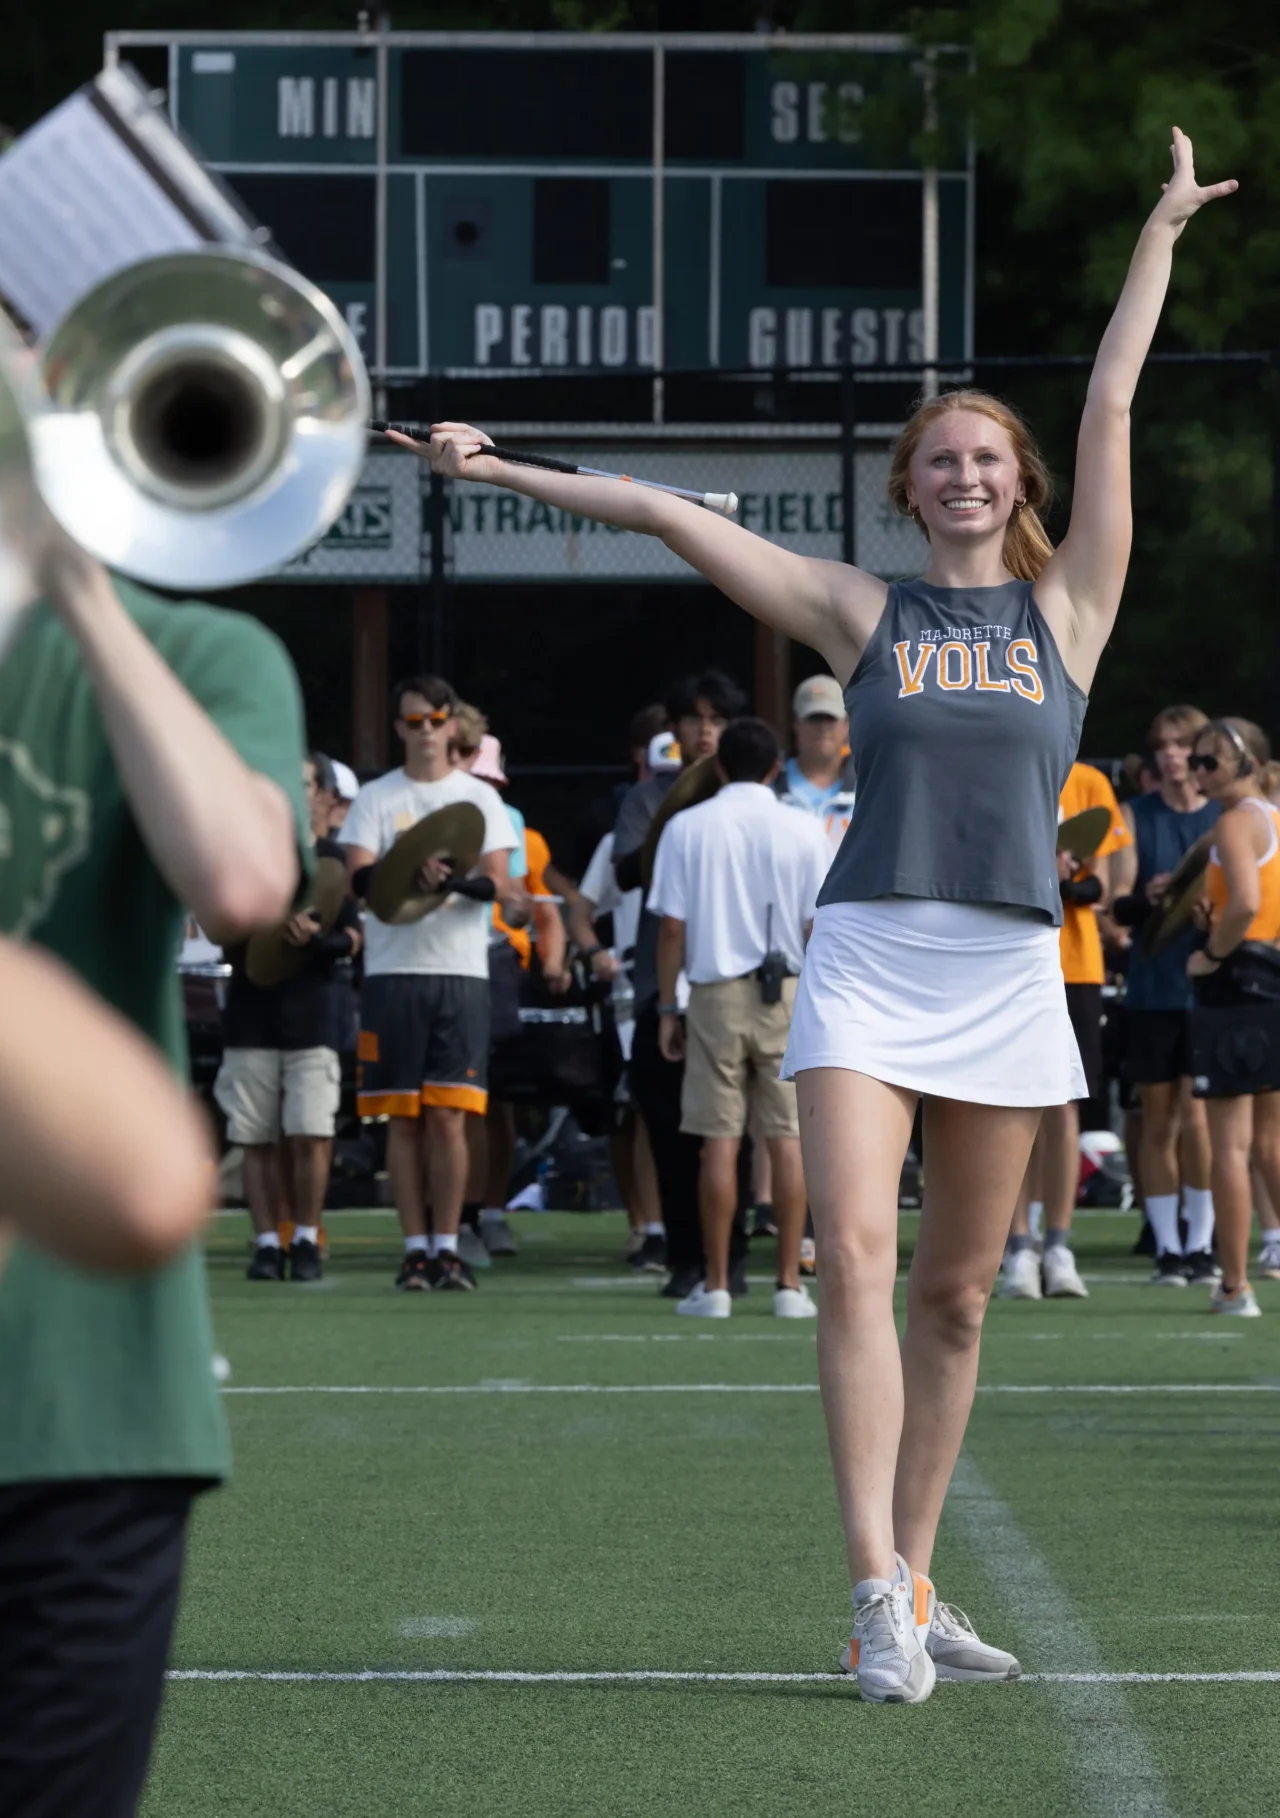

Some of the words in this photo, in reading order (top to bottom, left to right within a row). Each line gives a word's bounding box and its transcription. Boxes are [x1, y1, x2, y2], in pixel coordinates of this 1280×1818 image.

[277, 76, 375, 138] MIN
[770, 80, 866, 144] SEC
[474, 303, 656, 367] PERIOD
[748, 306, 927, 368] GUESTS
[738, 492, 846, 533] FIELD
[919, 624, 1013, 642] MAJORETTE
[892, 638, 1045, 706] VOLS
